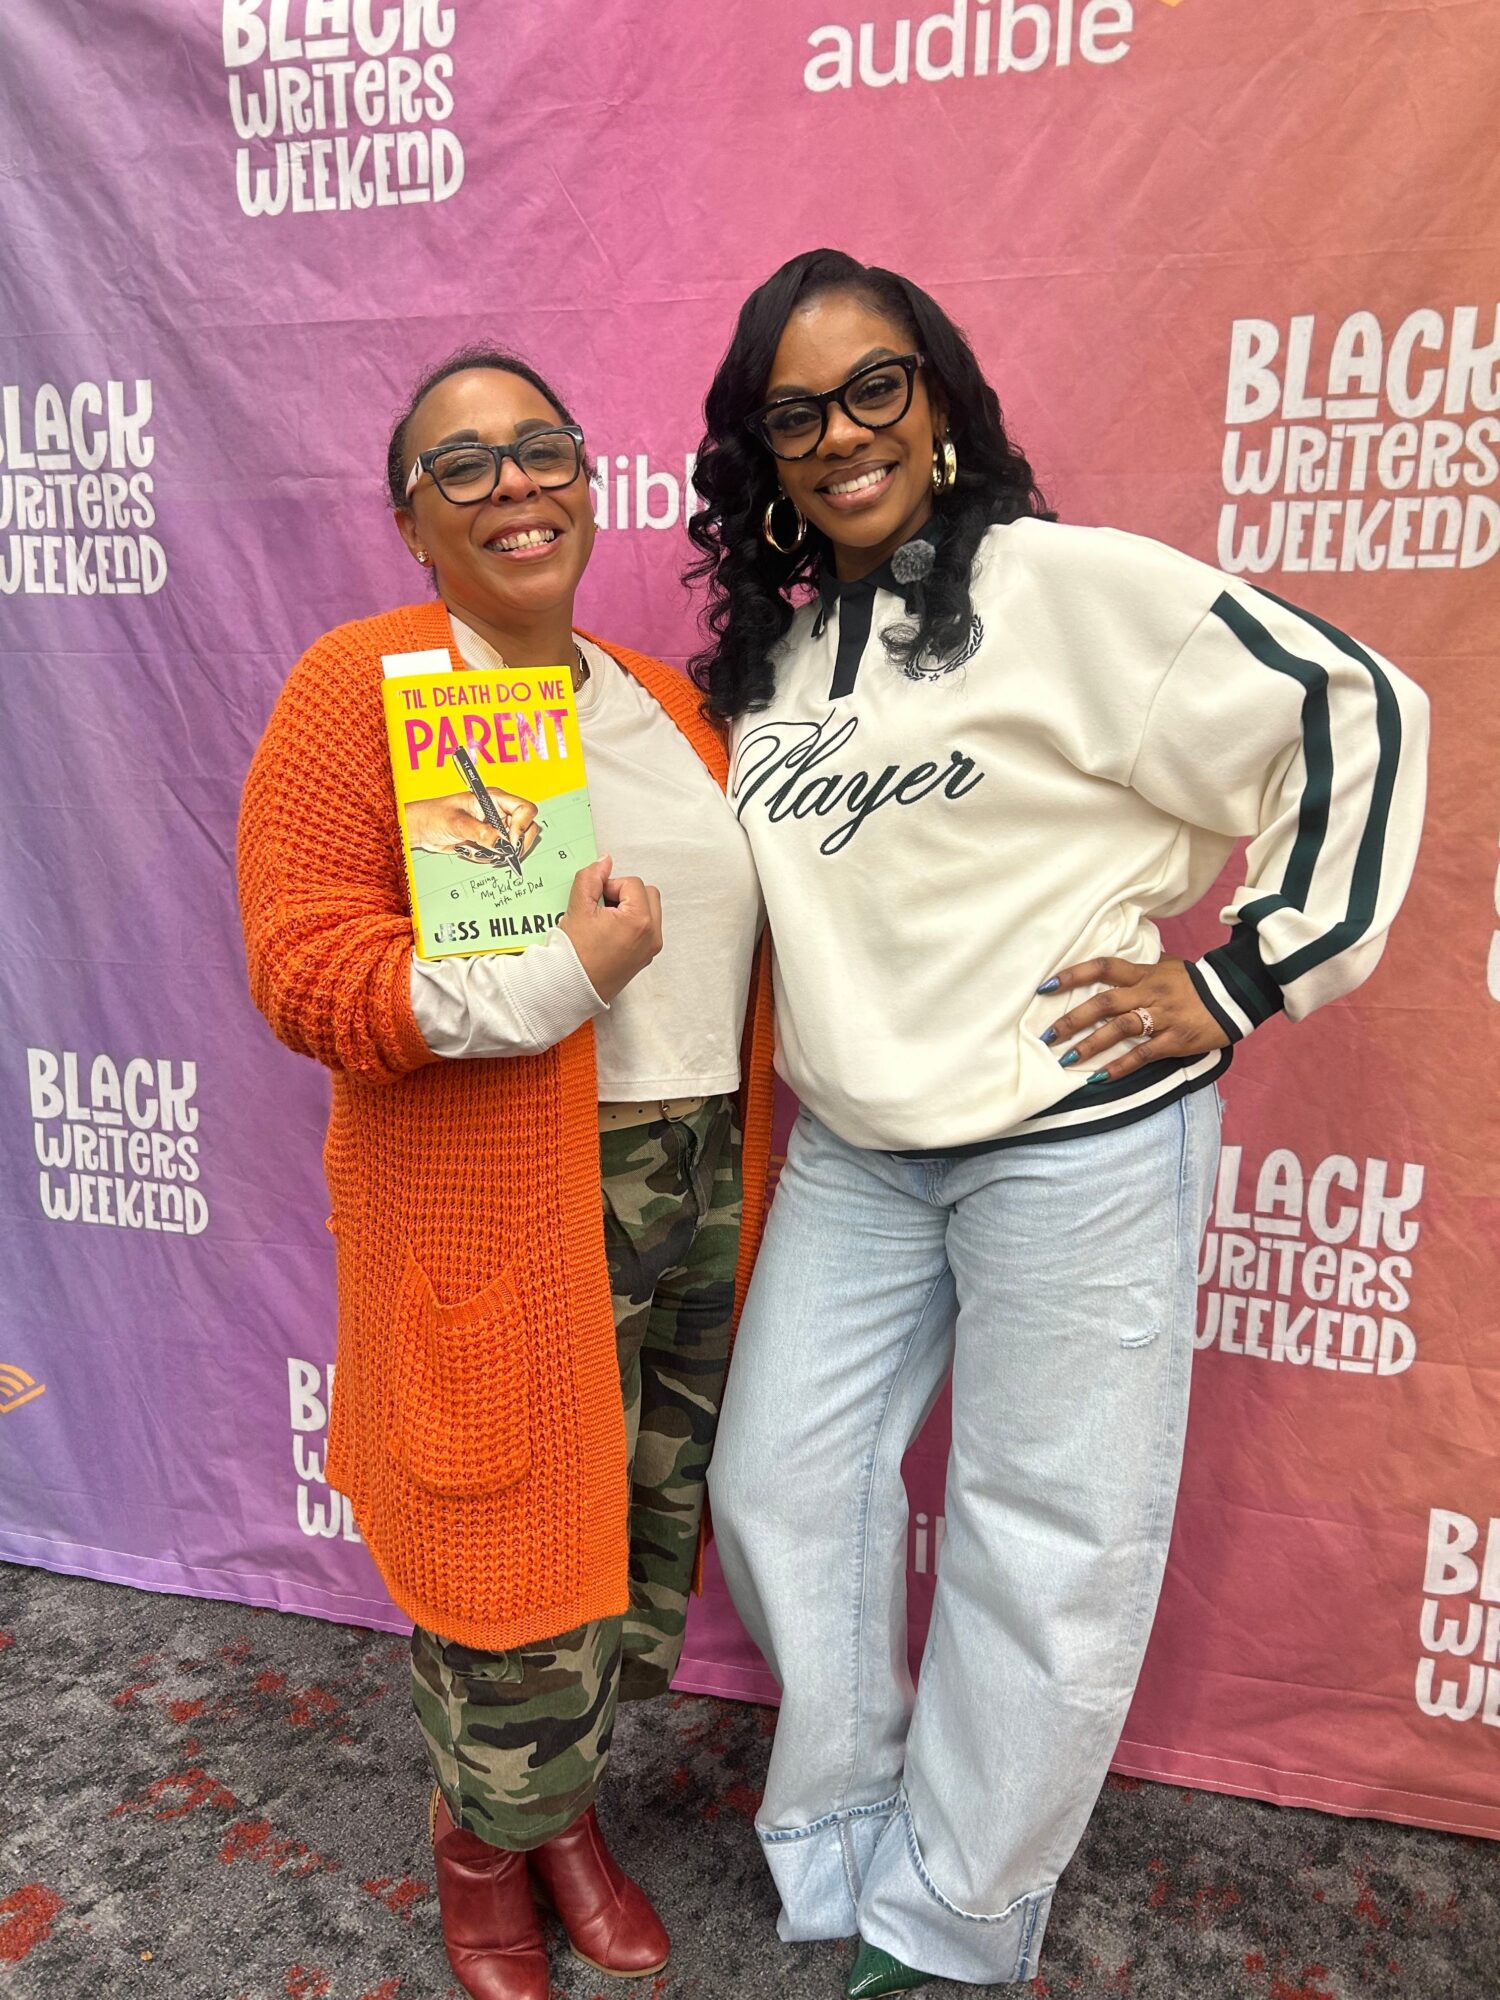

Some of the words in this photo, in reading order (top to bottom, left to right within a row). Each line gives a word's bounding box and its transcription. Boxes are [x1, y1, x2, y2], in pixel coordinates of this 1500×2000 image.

[803, 0, 1133, 92] audible
[1225, 303, 1500, 424] BLACK
[0, 379, 155, 470] LACK
[433, 684, 491, 707] DEATH
[496, 682, 532, 703] DO
[538, 680, 565, 701] WE
[405, 709, 568, 770] PARENT
[733, 707, 985, 856] Player
[558, 850, 568, 860] 8
[469, 875, 498, 893] Raising
[505, 869, 513, 879] 7
[450, 889, 460, 900] 6
[480, 889, 496, 900] My
[497, 881, 513, 895] Kid
[494, 895, 513, 908] with
[527, 876, 544, 894] Dad
[434, 920, 480, 944] JESS
[27, 1048, 200, 1133] BLACK
[1212, 1145, 1425, 1252] LACK
